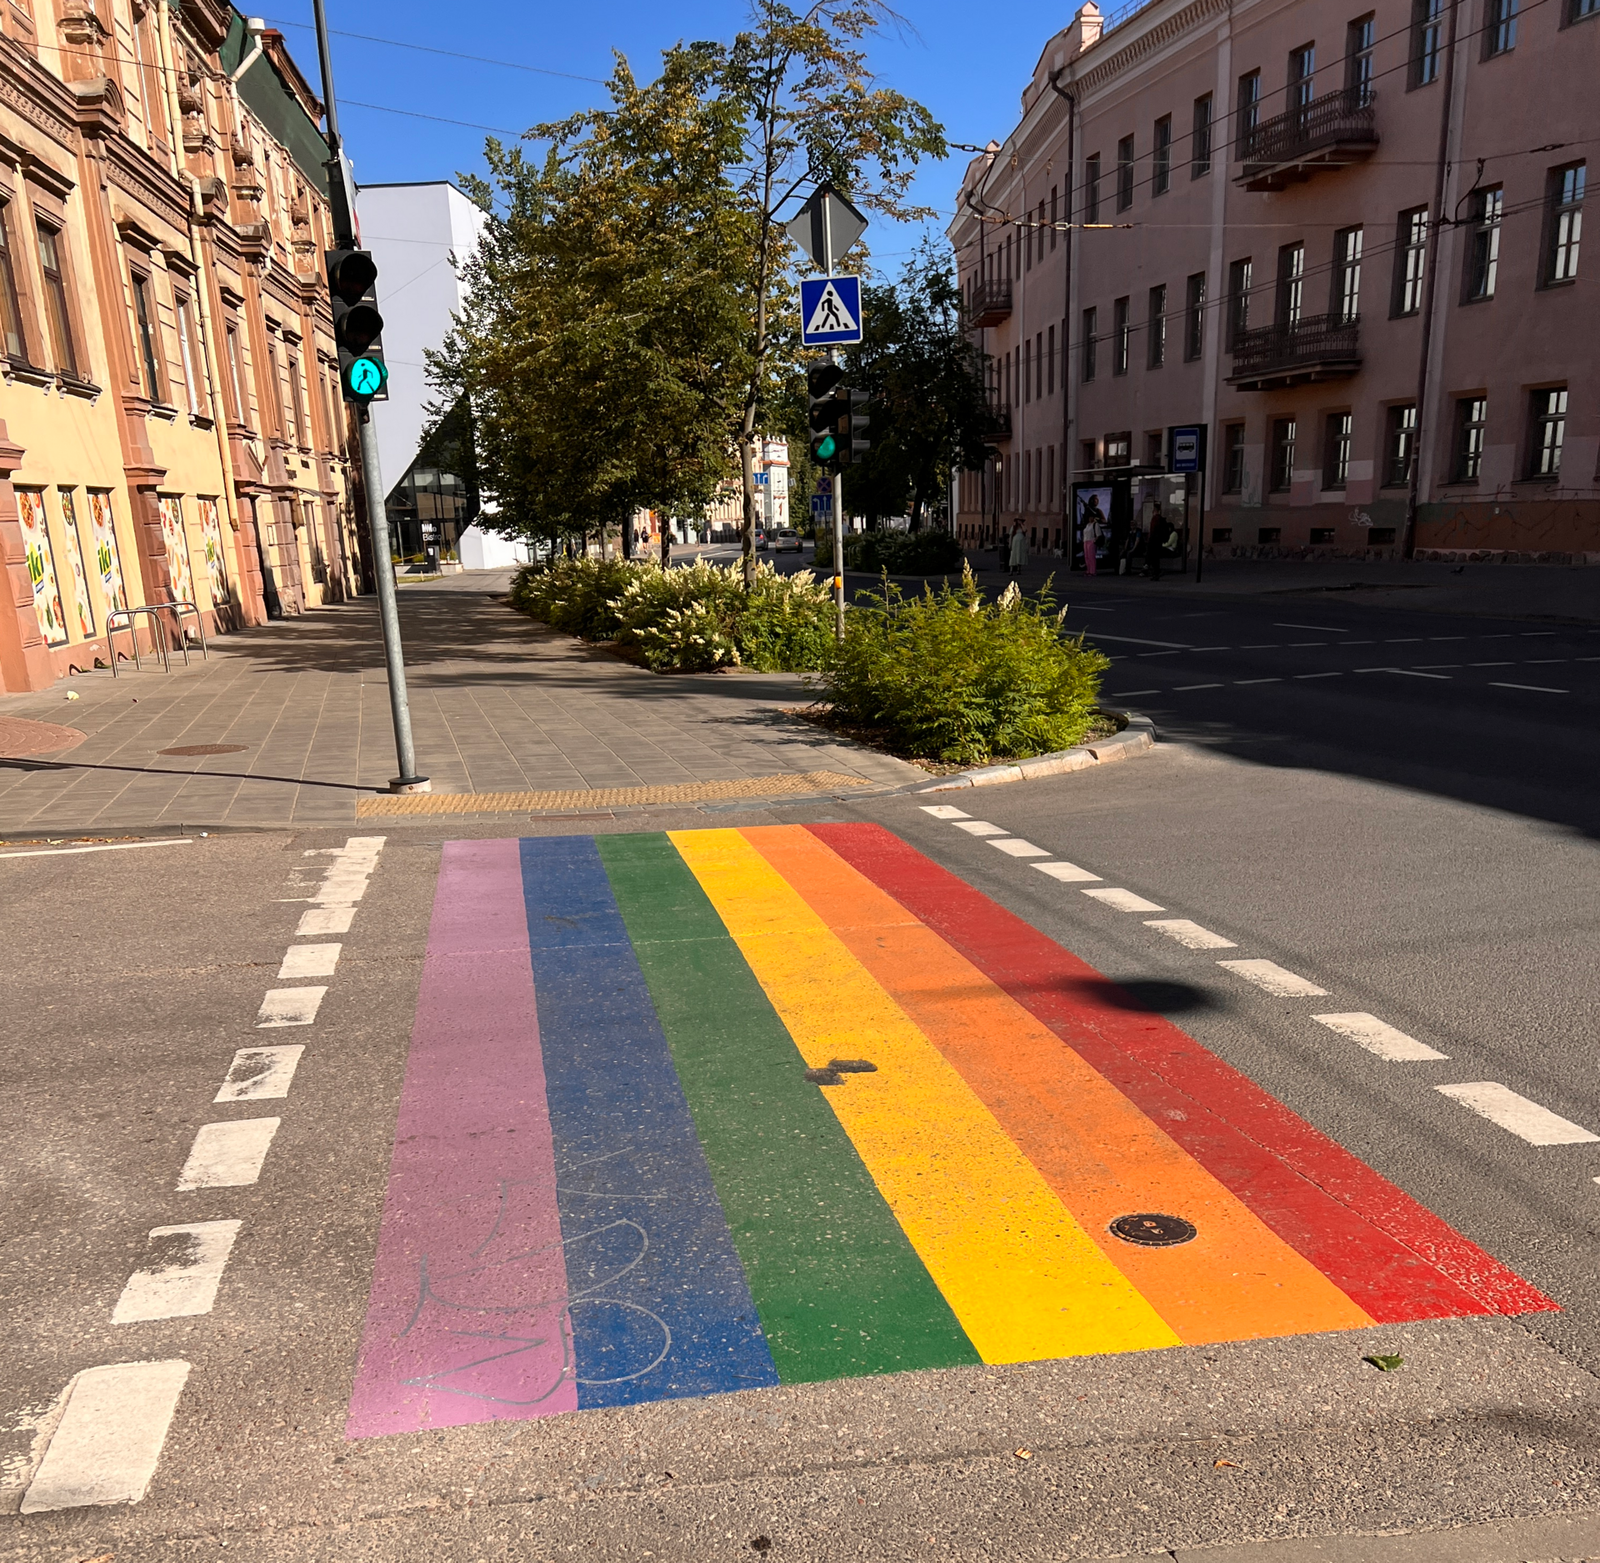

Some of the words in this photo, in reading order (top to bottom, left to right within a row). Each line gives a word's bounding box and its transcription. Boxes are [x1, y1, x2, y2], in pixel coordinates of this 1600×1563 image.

[422, 533, 442, 542] Bistro
[26, 544, 44, 582] iki
[97, 540, 112, 575] iki
